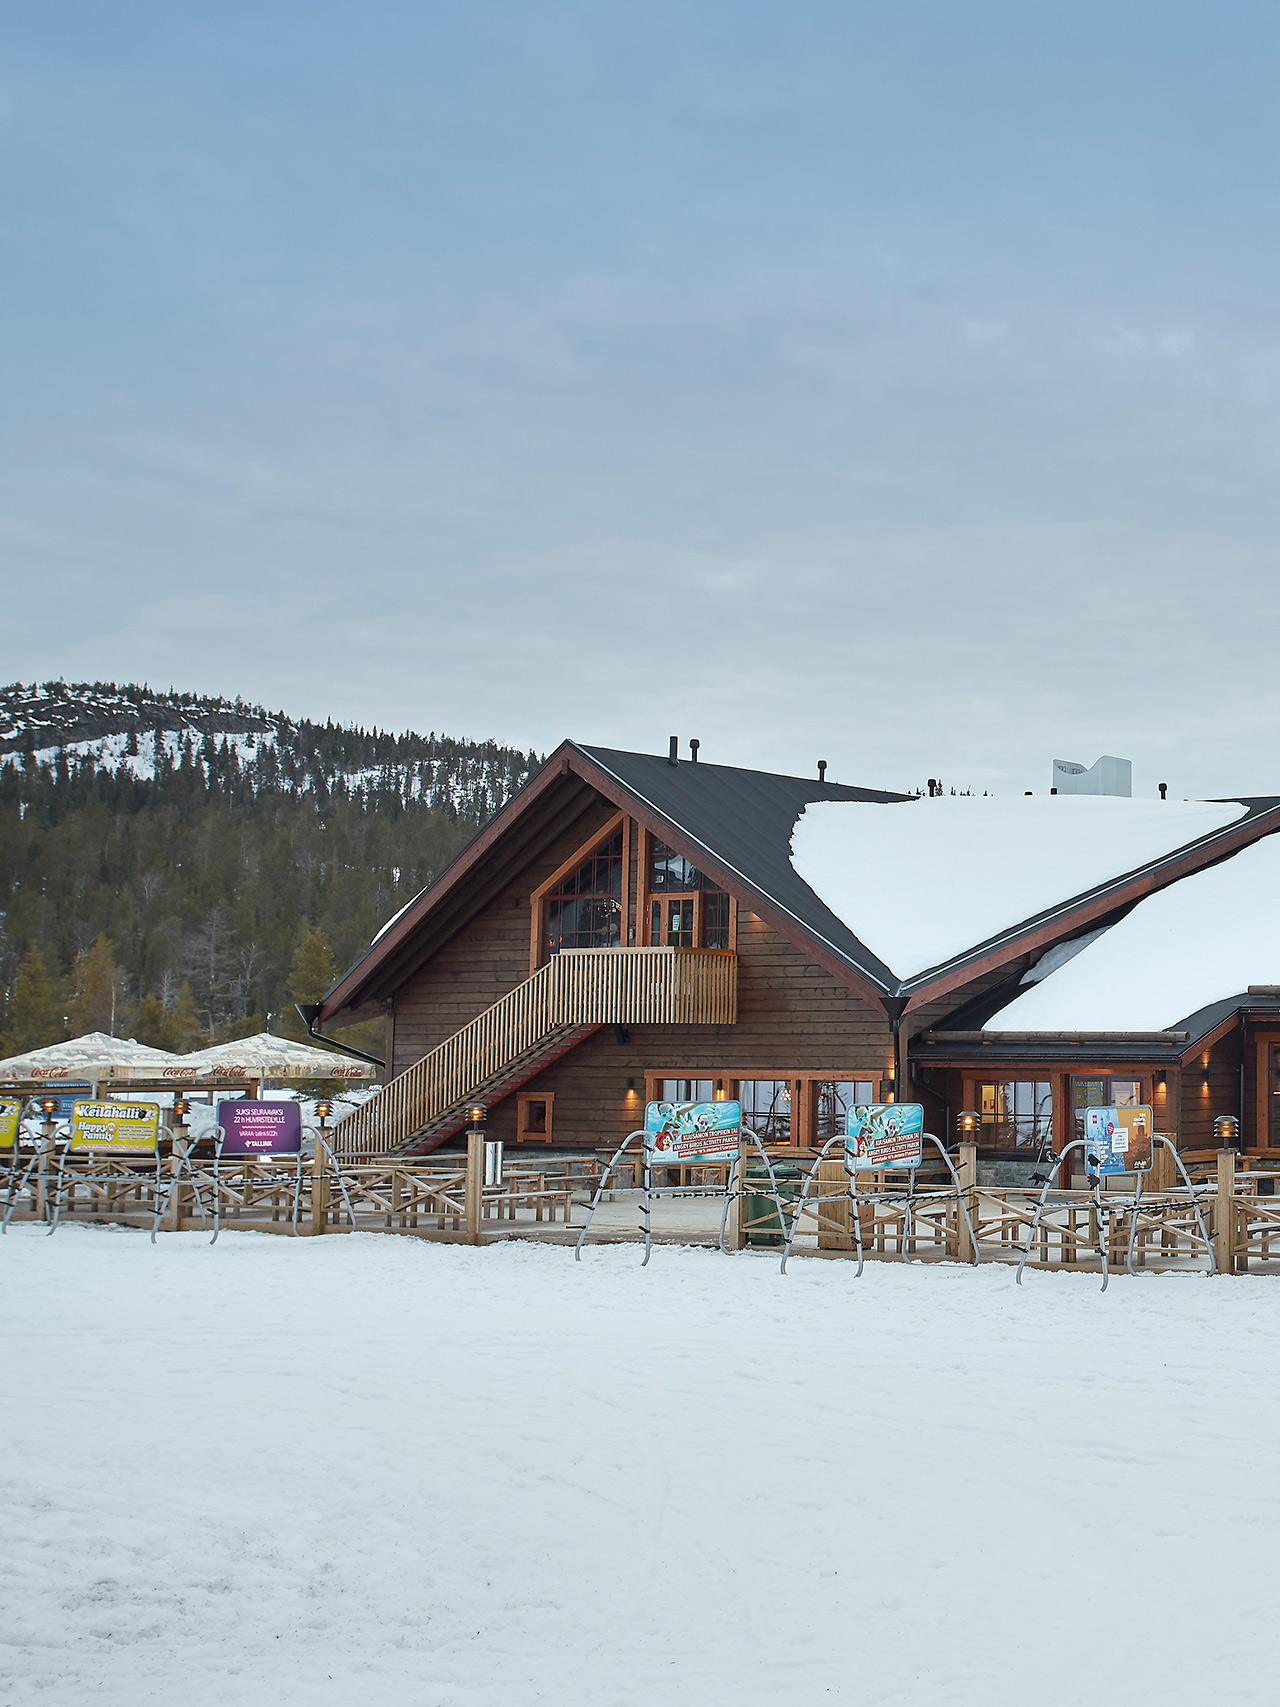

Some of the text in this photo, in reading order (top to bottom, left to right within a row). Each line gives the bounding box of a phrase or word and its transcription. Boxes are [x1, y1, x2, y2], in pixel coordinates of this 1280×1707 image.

[78, 1104, 140, 1119] Keilahalli
[77, 1121, 107, 1133] Happy
[82, 1131, 114, 1142] Family
